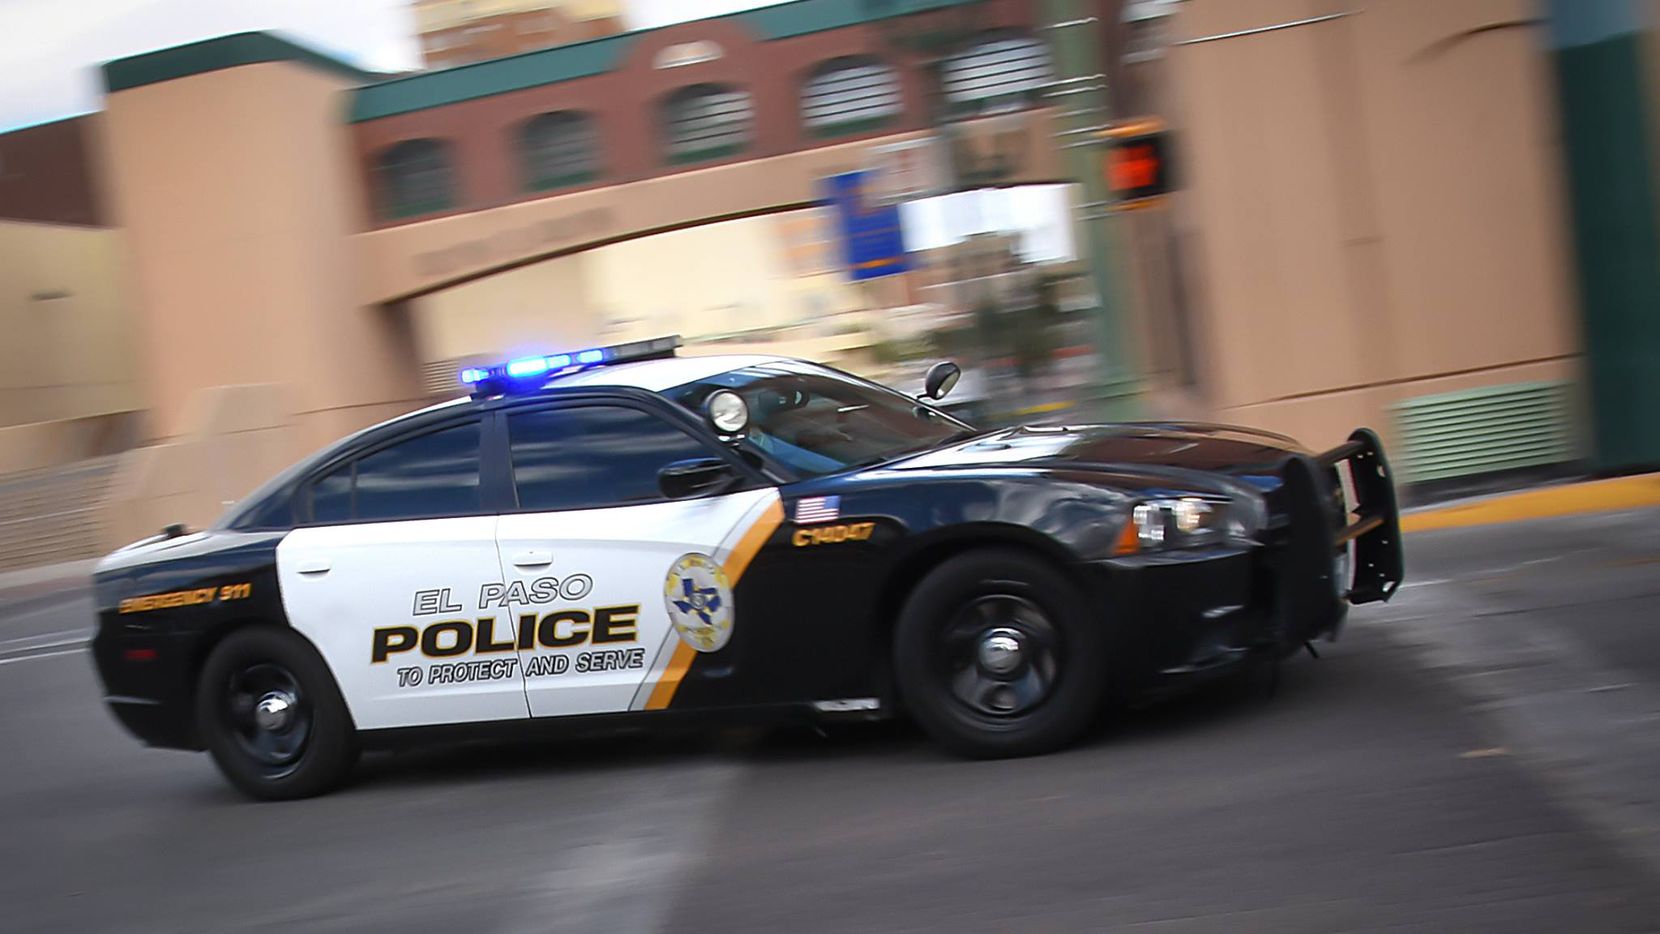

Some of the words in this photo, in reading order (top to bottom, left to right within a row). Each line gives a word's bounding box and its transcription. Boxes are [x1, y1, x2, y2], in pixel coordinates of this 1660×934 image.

[220, 583, 251, 601] 911
[412, 588, 462, 616] EL
[478, 572, 594, 610] PASO
[371, 604, 641, 665] POLICE
[397, 667, 424, 687] TO
[427, 657, 518, 684] PROTECT
[525, 654, 570, 677] AND
[575, 648, 646, 673] SERVE
